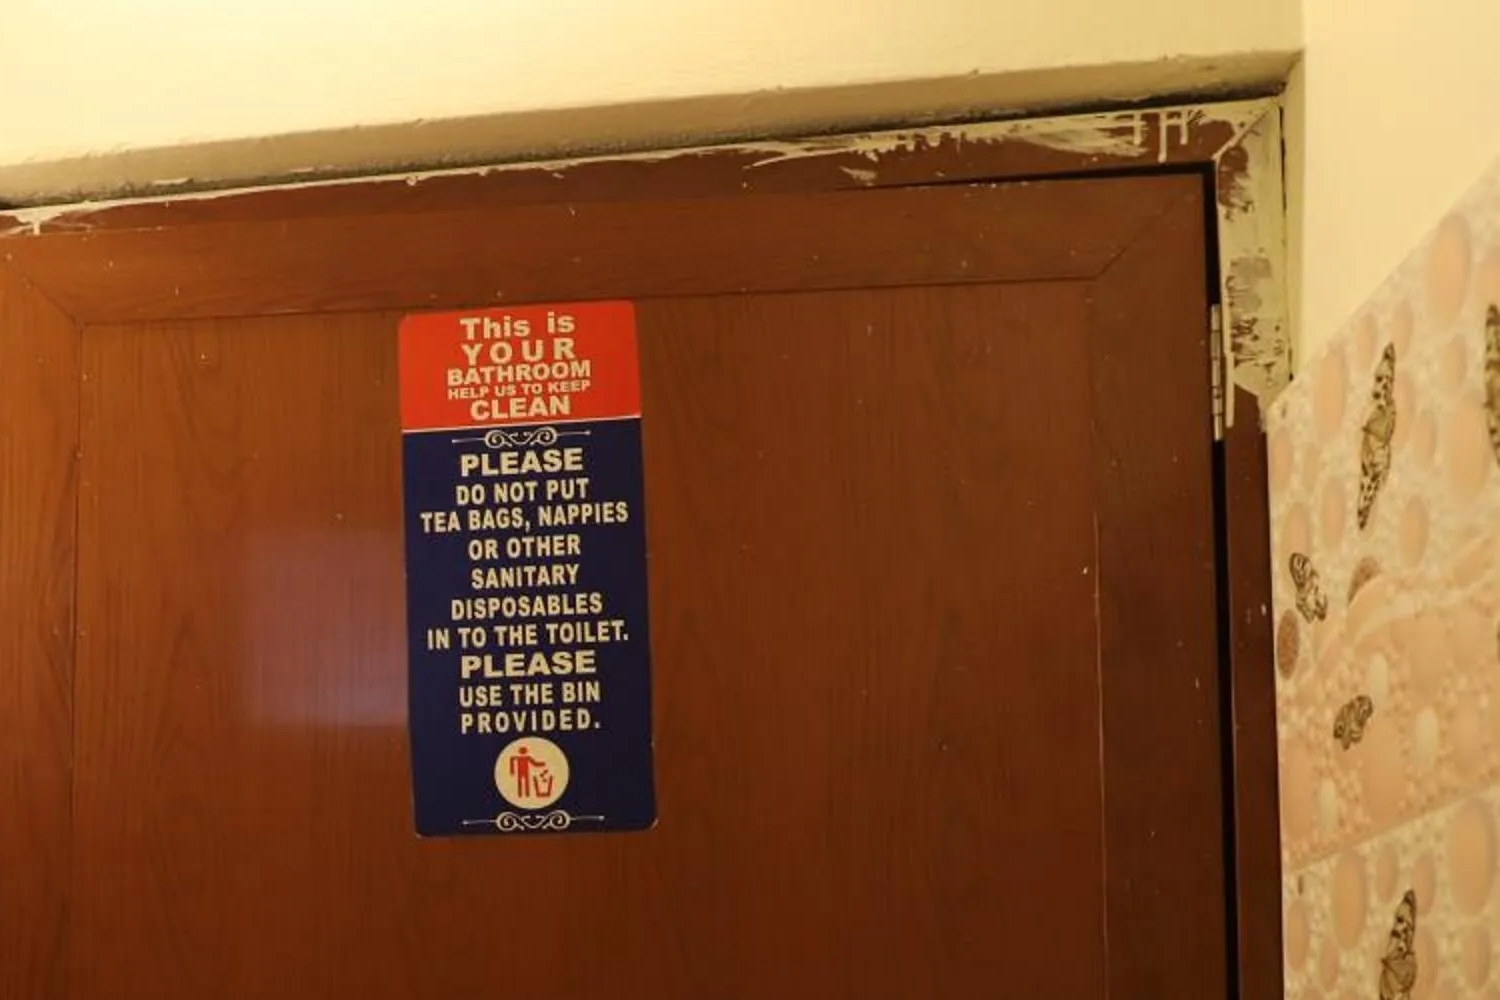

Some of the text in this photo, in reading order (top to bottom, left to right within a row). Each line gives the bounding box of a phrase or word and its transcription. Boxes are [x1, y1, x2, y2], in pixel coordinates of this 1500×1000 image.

[460, 312, 575, 340] This is
[461, 338, 576, 365] YOUR
[447, 360, 591, 386] BATHROOM
[448, 380, 591, 399] HELP US TO KEEP
[470, 396, 570, 420] CLEAN
[460, 448, 583, 477] PLEASE
[456, 478, 589, 505] DO NOT PUT
[420, 502, 628, 533] TEA BAGS, NAPPIES
[469, 534, 581, 560] OR OTHER
[471, 564, 579, 589] SANITARY
[451, 593, 602, 620] DISPOSABLES
[427, 620, 629, 649] IN TO THE TOILET.
[460, 650, 597, 678] PLEASE
[459, 681, 600, 707] USE THE BIN
[460, 709, 601, 734] PROVIDED.
